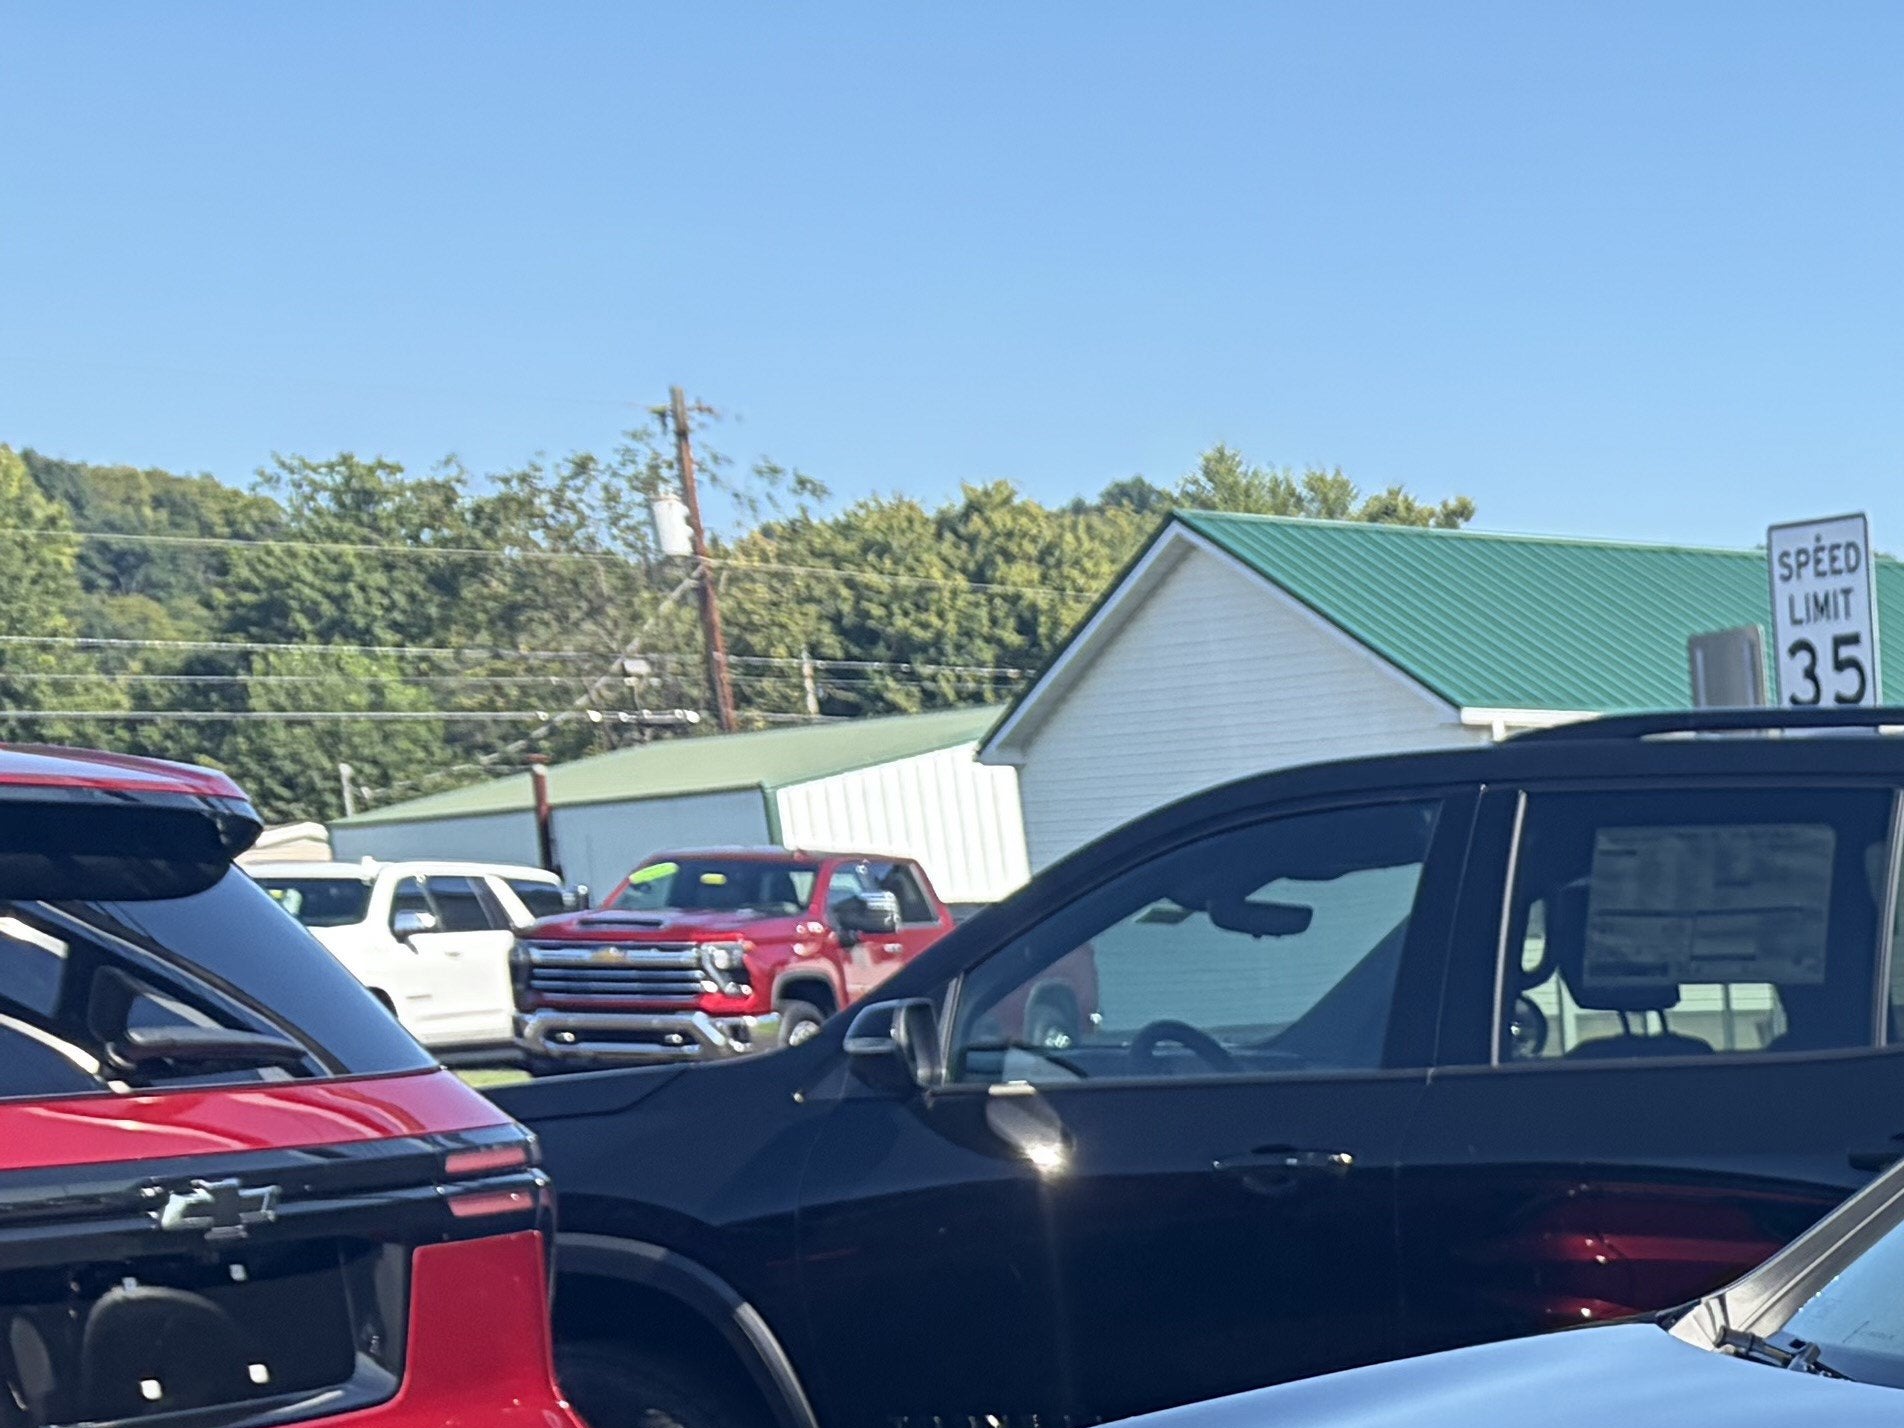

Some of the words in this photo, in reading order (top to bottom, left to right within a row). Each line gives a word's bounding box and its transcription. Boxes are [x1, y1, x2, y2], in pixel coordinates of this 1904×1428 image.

[1778, 541, 1861, 582] SPEED
[1788, 587, 1854, 626] LIMIT
[1787, 631, 1867, 706] 35
